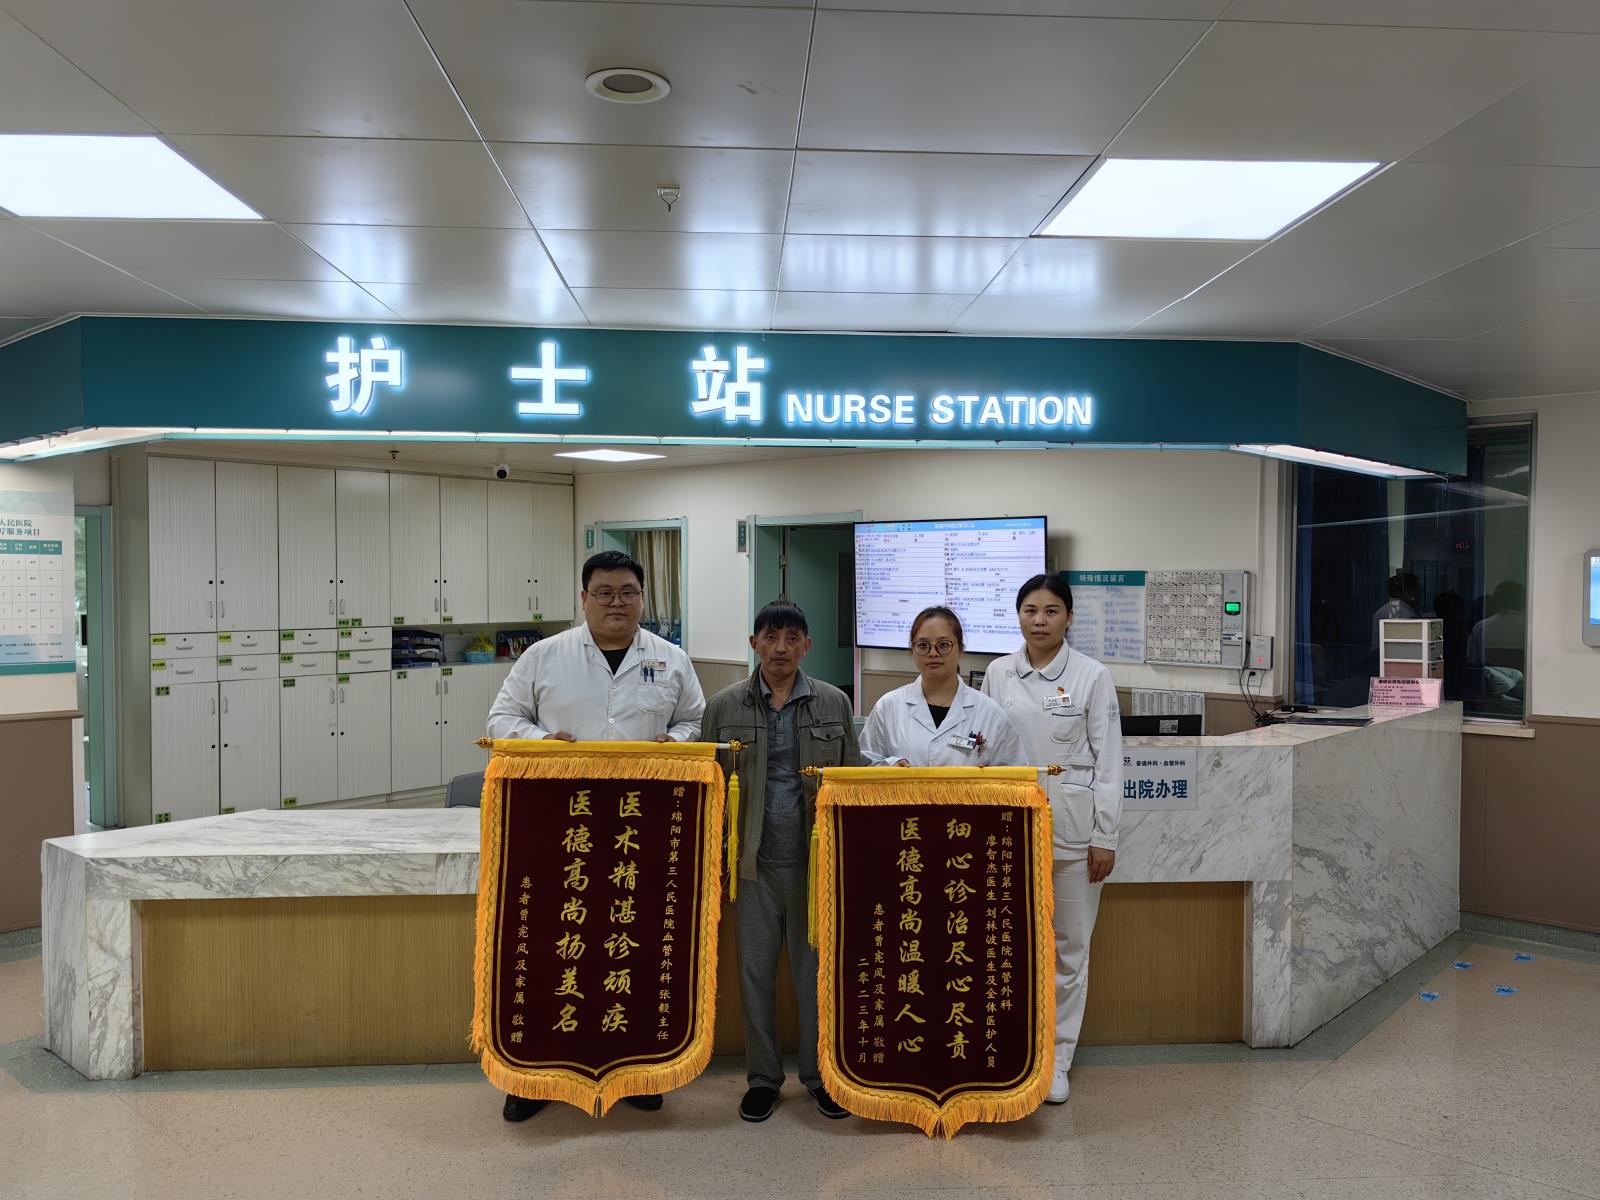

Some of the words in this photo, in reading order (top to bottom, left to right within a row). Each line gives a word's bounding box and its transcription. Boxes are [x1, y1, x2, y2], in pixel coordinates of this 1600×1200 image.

[326, 336, 766, 422] 护士站
[786, 394, 915, 424] NURSE
[930, 395, 1093, 426] STATION
[1123, 779, 1188, 799] 出院办理
[553, 789, 594, 1032] 医德高尚扬美名
[602, 791, 643, 1033] 医术精湛诊顽疾
[894, 816, 927, 1055] 医德高尚温暖人心
[944, 817, 977, 1061] 细心诊治尽心尽责
[857, 957, 870, 1064] 二零二三年十月
